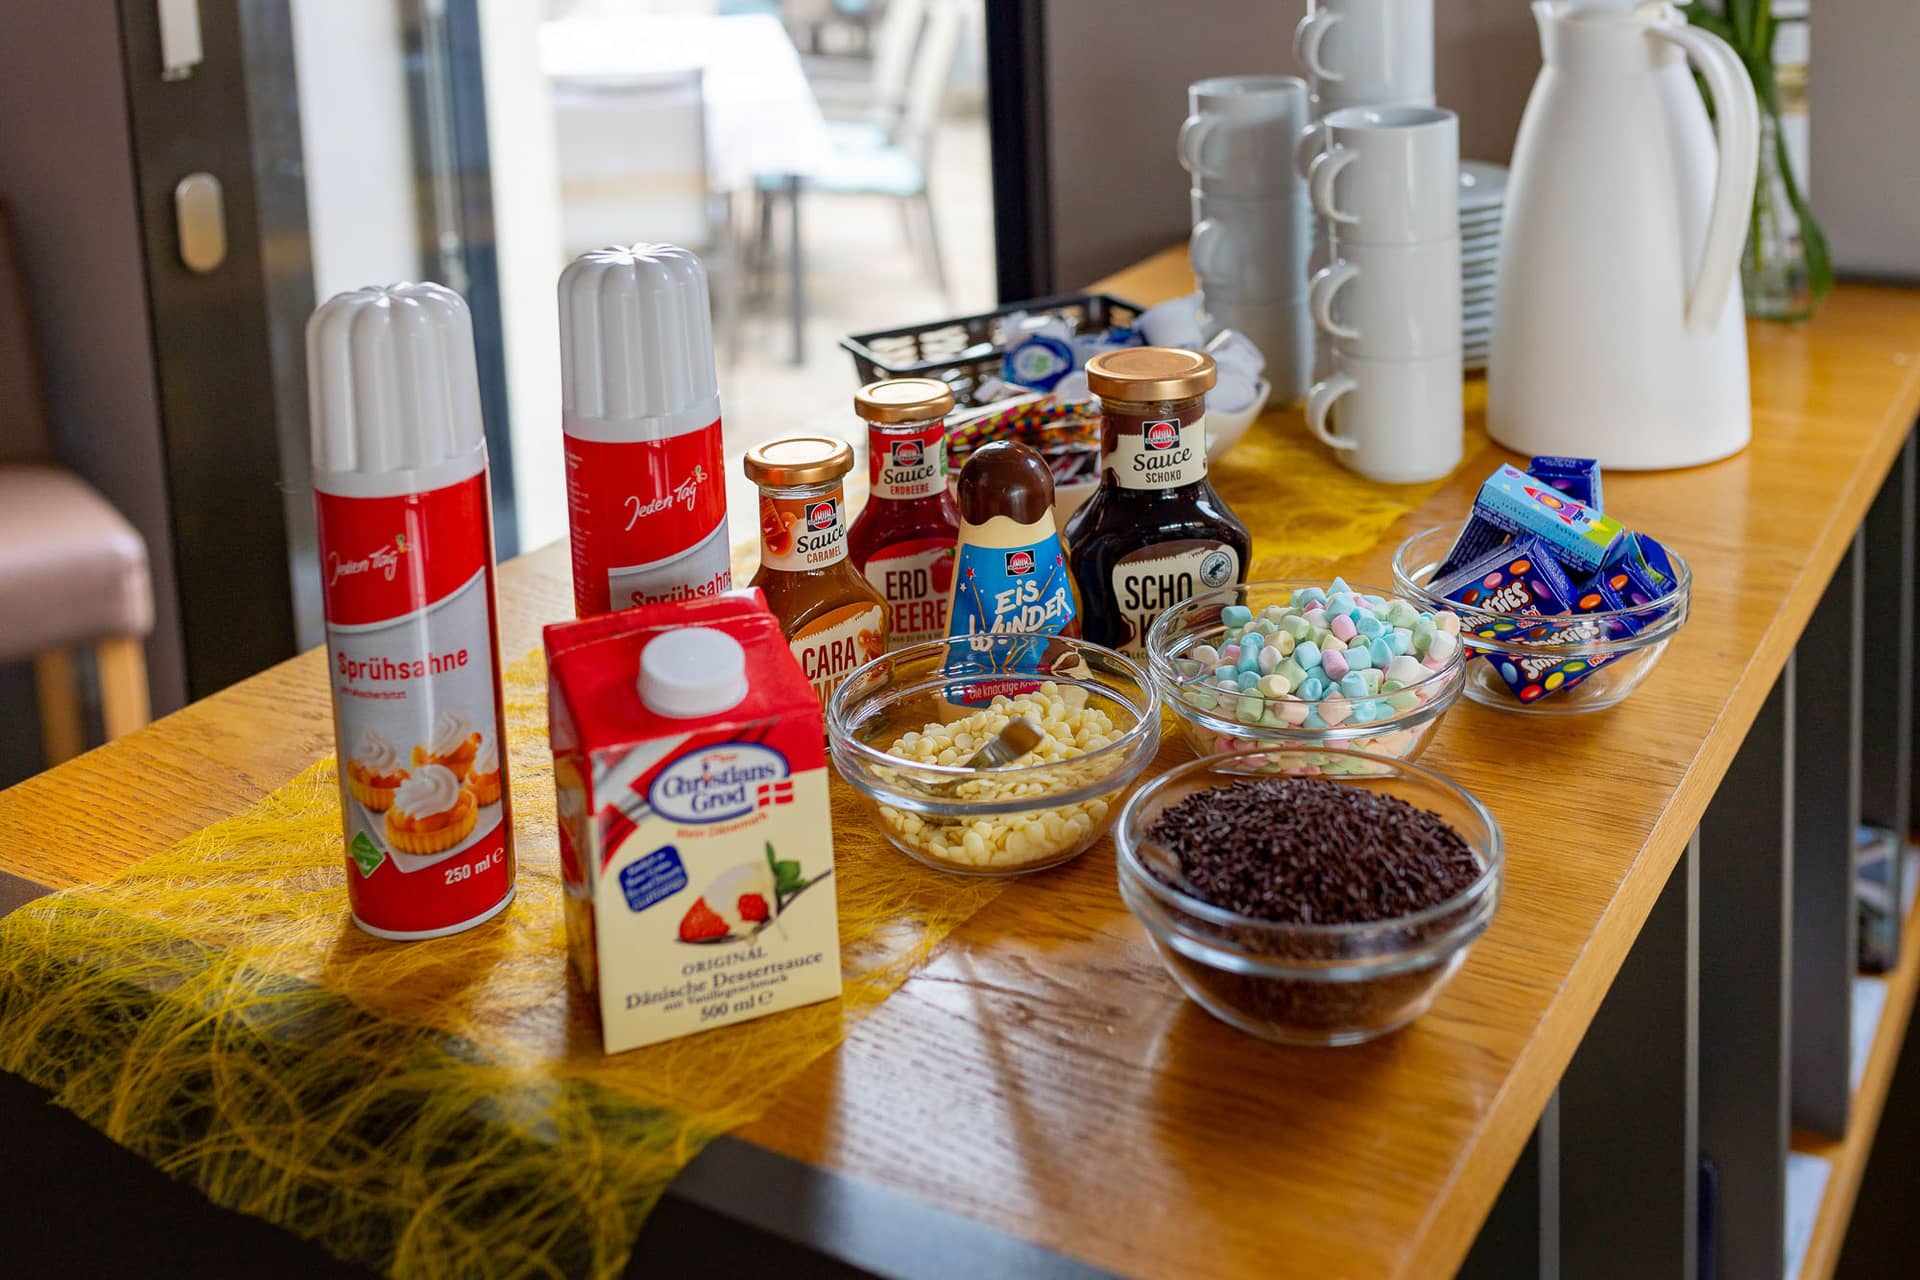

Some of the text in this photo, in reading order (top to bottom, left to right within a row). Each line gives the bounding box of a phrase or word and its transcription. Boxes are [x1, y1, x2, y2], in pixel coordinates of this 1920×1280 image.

[883, 464, 935, 485] Sauce
[1133, 447, 1192, 472] Sauce
[890, 483, 929, 496] ERDBEERE
[1145, 470, 1182, 484] SCHOKO
[624, 477, 697, 532] Jeden Tag
[796, 523, 845, 555] Sauce
[806, 544, 842, 564] CARAMEL
[369, 545, 398, 581] Tag
[885, 568, 928, 600] ERD
[1124, 572, 1193, 610] SCHO
[338, 649, 468, 684] Sprühsahne
[801, 636, 858, 681] CARA
[662, 763, 776, 798] Christians
[444, 864, 471, 885] 250
[475, 855, 490, 876] ml
[681, 946, 768, 977] ORIGINAL
[625, 951, 824, 1011] Dänische Dessertsauce
[700, 1002, 729, 1022] 500
[733, 995, 755, 1013] ml
